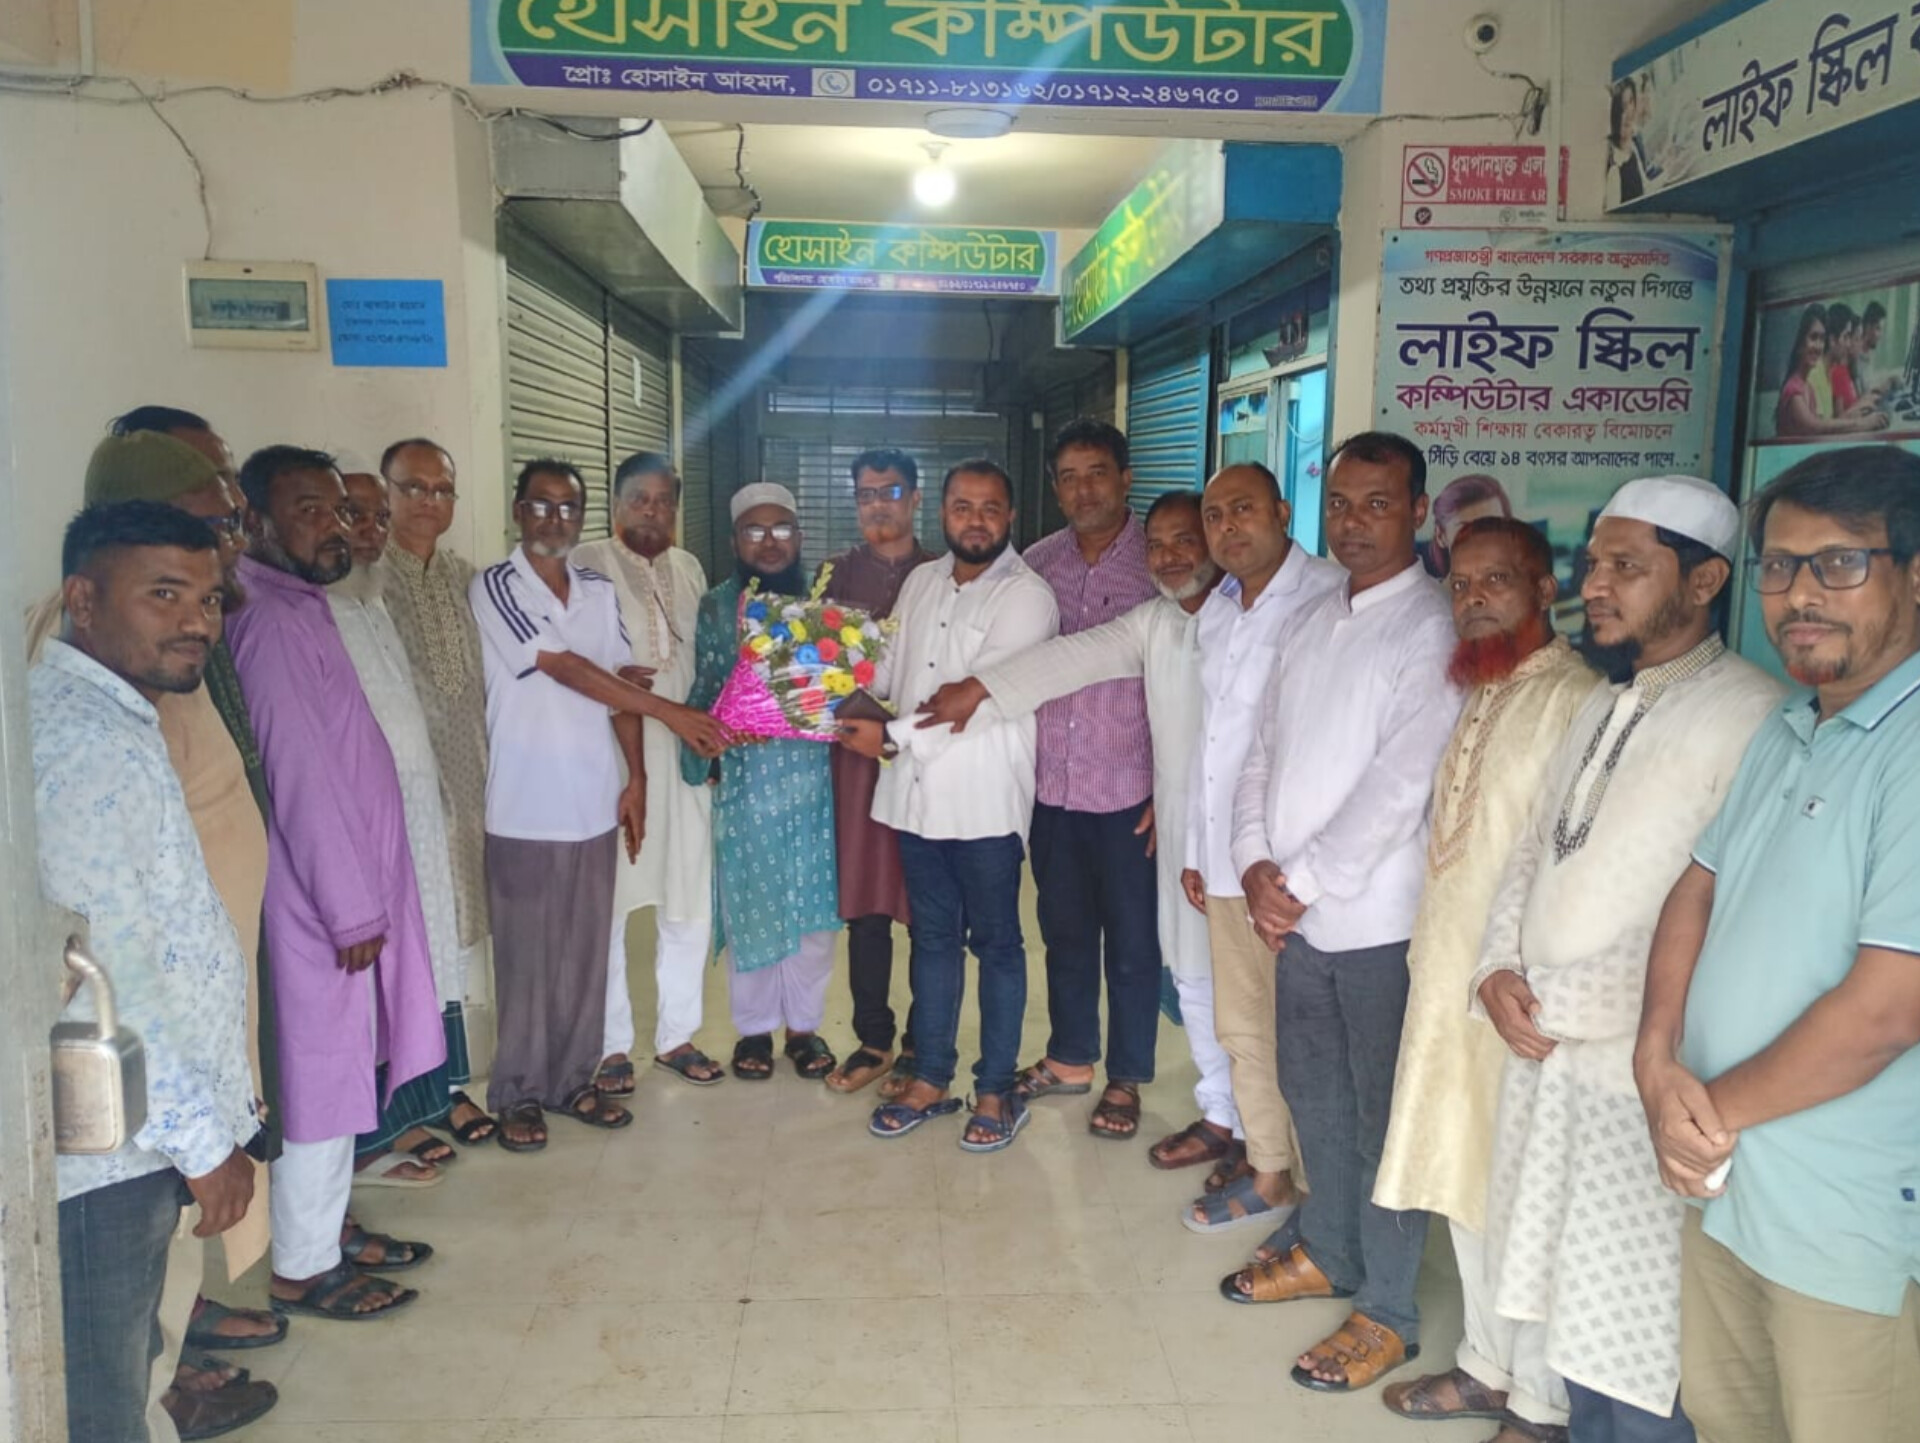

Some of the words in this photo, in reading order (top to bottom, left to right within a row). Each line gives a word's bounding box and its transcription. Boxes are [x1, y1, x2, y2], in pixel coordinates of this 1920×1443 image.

[518, 0, 862, 53] হোসাইন
[621, 66, 708, 89] হোসাইন
[713, 71, 797, 95] আহমদ,
[866, 77, 1240, 104] ০১৭১১-৮১৩১৬২/০১৭১২-২৪৬৭৫০
[1702, 59, 1799, 152] লাইফ
[1806, 13, 1899, 115] স্কিল
[1449, 188, 1492, 201] SMOKE
[1495, 188, 1526, 201] FREE
[764, 228, 877, 266] হোসাইন
[886, 231, 1040, 272] কম্পিউটার
[1558, 251, 1604, 265] সরকার
[1399, 277, 1435, 296] তথ্য
[1441, 272, 1511, 302] প্রযুক্তির
[1517, 273, 1584, 305] উন্নয়নে
[1590, 278, 1635, 303] নতুন
[1396, 311, 1559, 373] লাইফ
[1576, 308, 1701, 372] স্কিল
[1396, 375, 1552, 412] কম্পিউটার
[1563, 377, 1693, 413] একাডেমি
[1476, 417, 1528, 438] শিক্ষায়
[1603, 418, 1673, 438] বিমোচনে
[1463, 450, 1496, 466] বেয়ে
[1500, 452, 1520, 465] ১৪
[1525, 450, 1567, 467] বৎসর
[1571, 451, 1640, 467] আপনাদের
